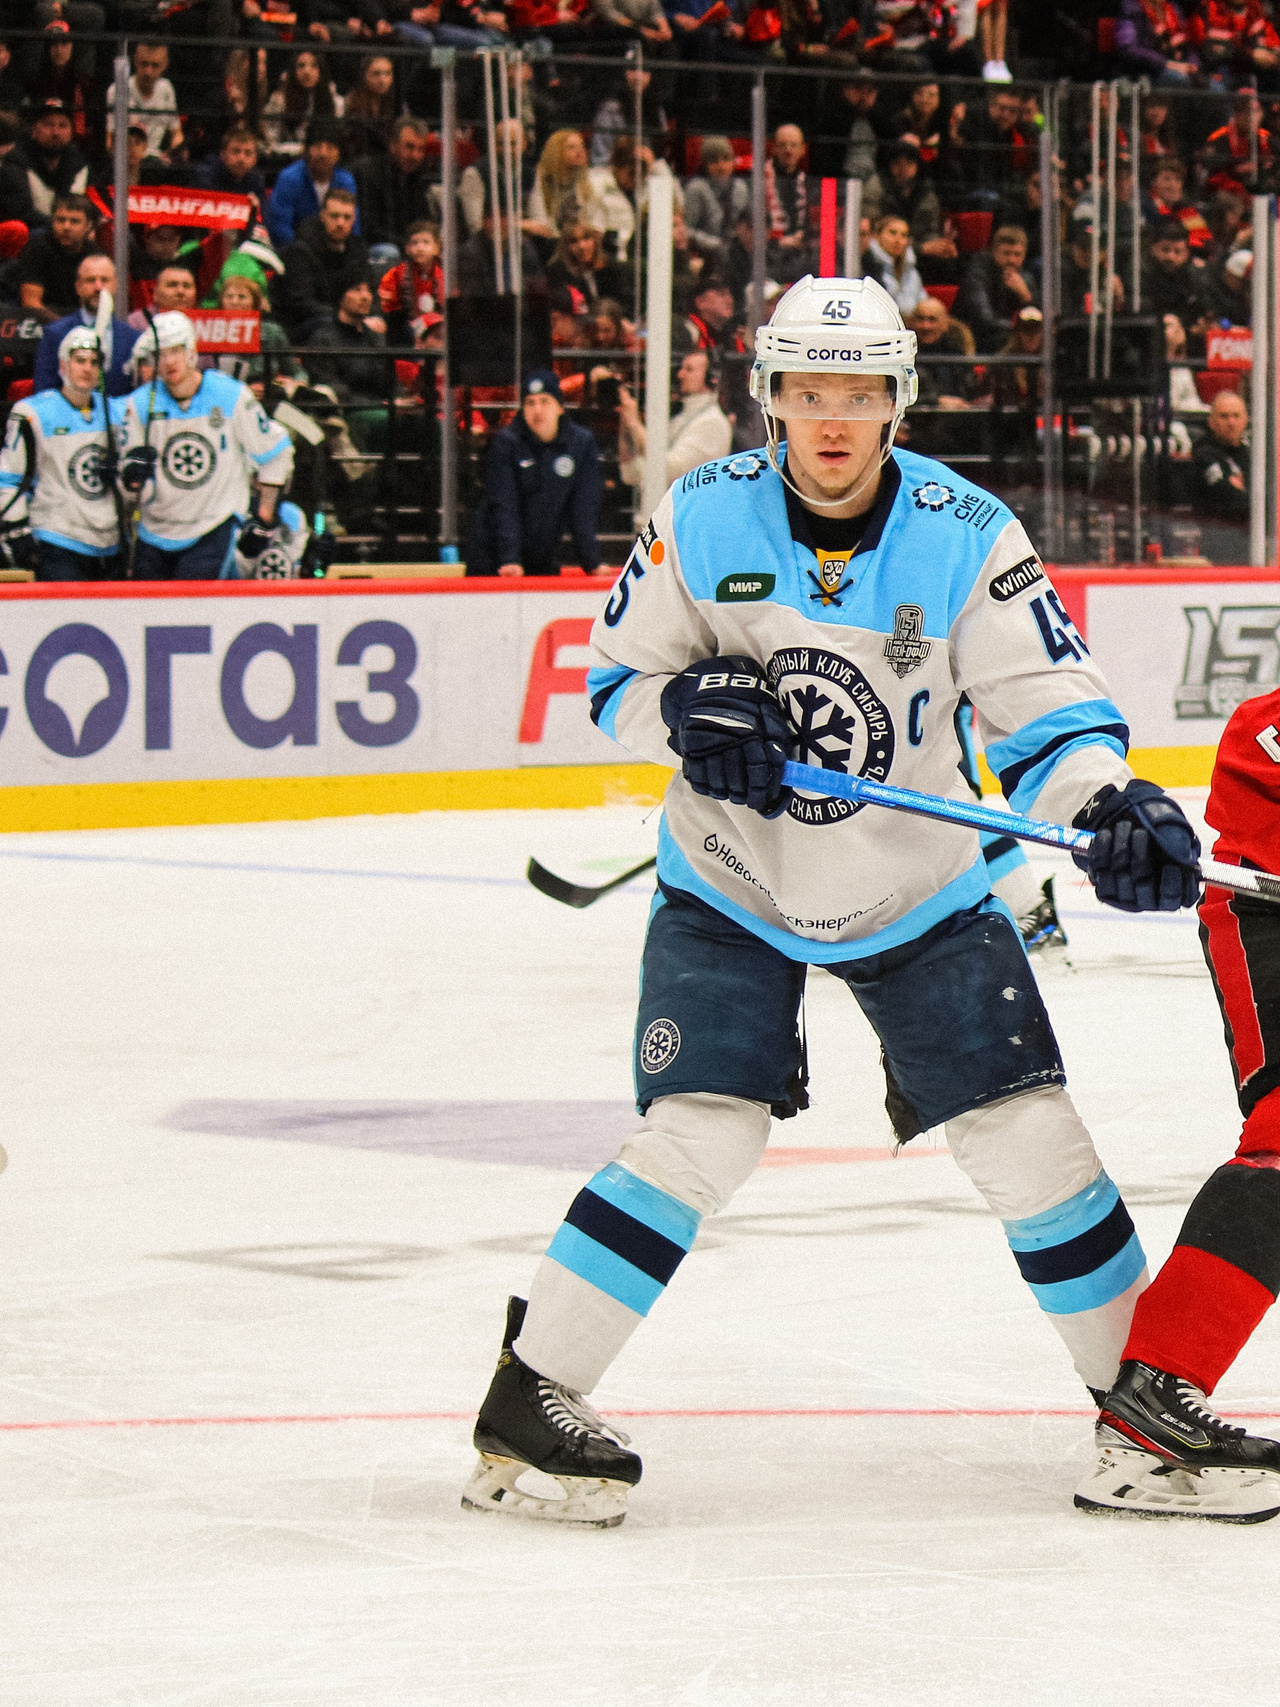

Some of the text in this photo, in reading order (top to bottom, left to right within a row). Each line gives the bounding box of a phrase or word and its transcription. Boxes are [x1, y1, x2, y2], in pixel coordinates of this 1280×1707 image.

[822, 300, 852, 320] 45
[195, 318, 259, 343] NBET
[954, 494, 980, 520] СИБ
[729, 582, 762, 593] МИР
[994, 562, 1043, 596] Winlin
[0, 619, 420, 758] огаз
[815, 656, 856, 685] КЛУБ
[850, 681, 889, 742] СИБИРЬ
